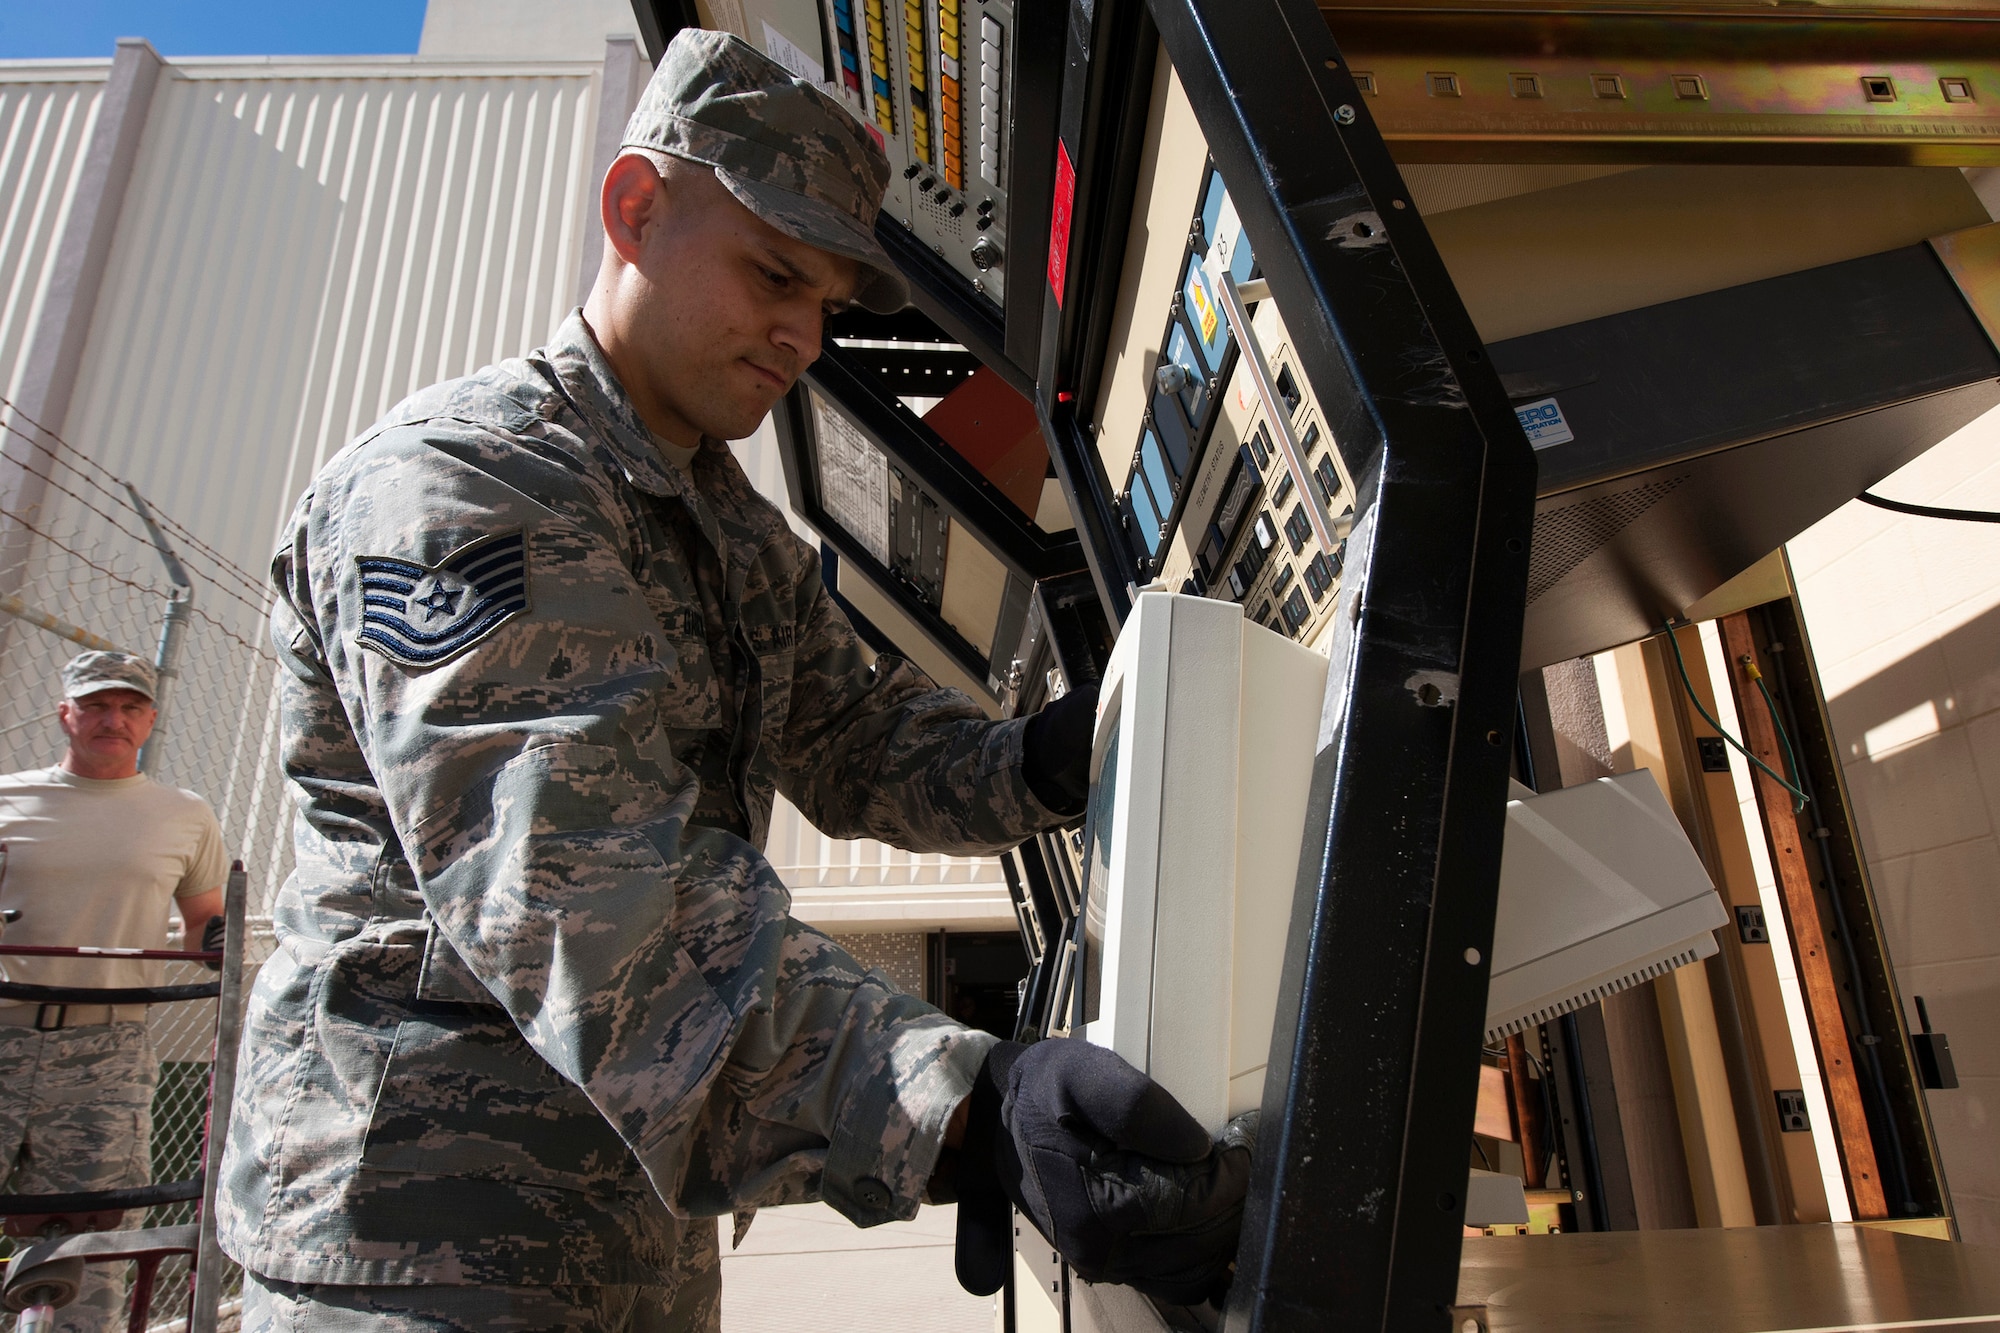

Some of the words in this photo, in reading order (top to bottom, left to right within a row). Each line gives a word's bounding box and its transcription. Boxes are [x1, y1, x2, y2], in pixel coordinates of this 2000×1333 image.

[1195, 468, 1213, 510] TELEMETRY
[1211, 440, 1225, 472] STATUS
[771, 624, 793, 648] AIR
